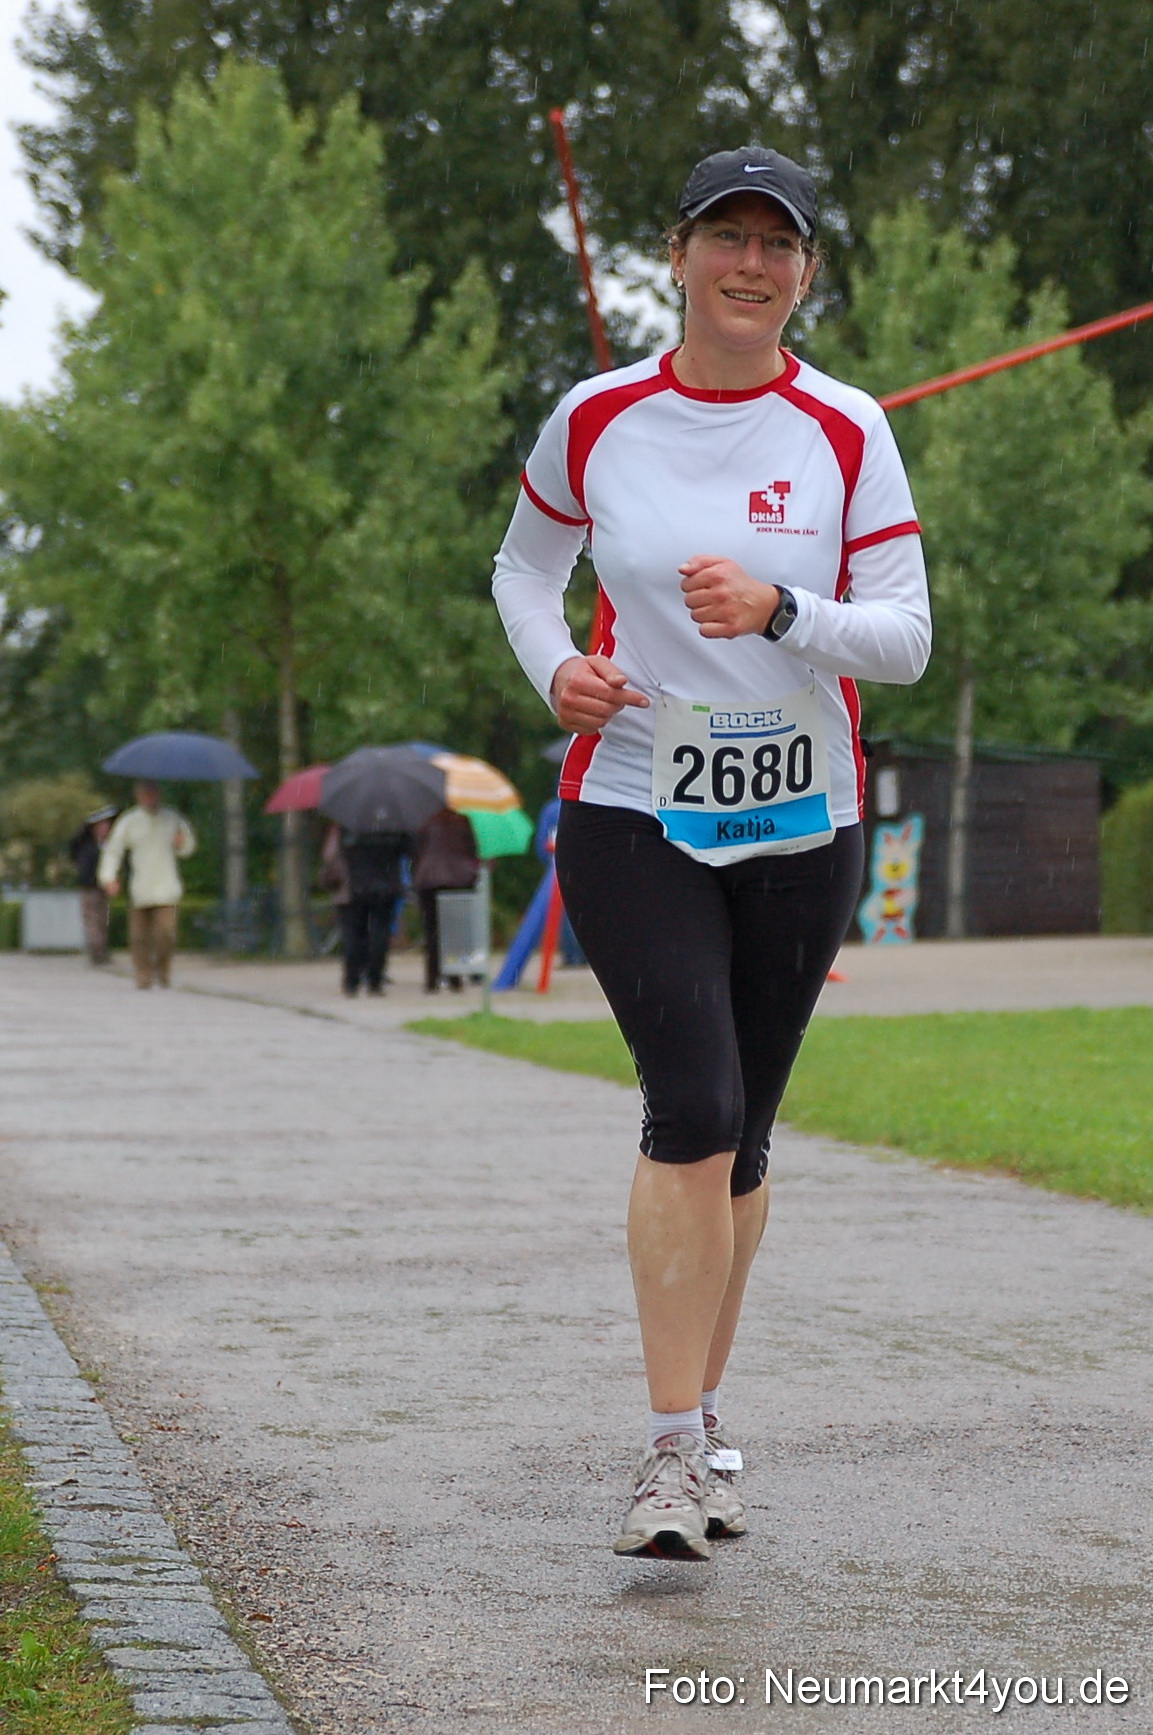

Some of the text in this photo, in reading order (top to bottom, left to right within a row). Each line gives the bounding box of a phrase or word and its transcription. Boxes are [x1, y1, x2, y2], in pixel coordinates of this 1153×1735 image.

[750, 511, 783, 523] DKMS
[710, 709, 783, 729] BOCK
[672, 734, 813, 807] 2680
[659, 796, 667, 807] D
[716, 815, 776, 842] Katja
